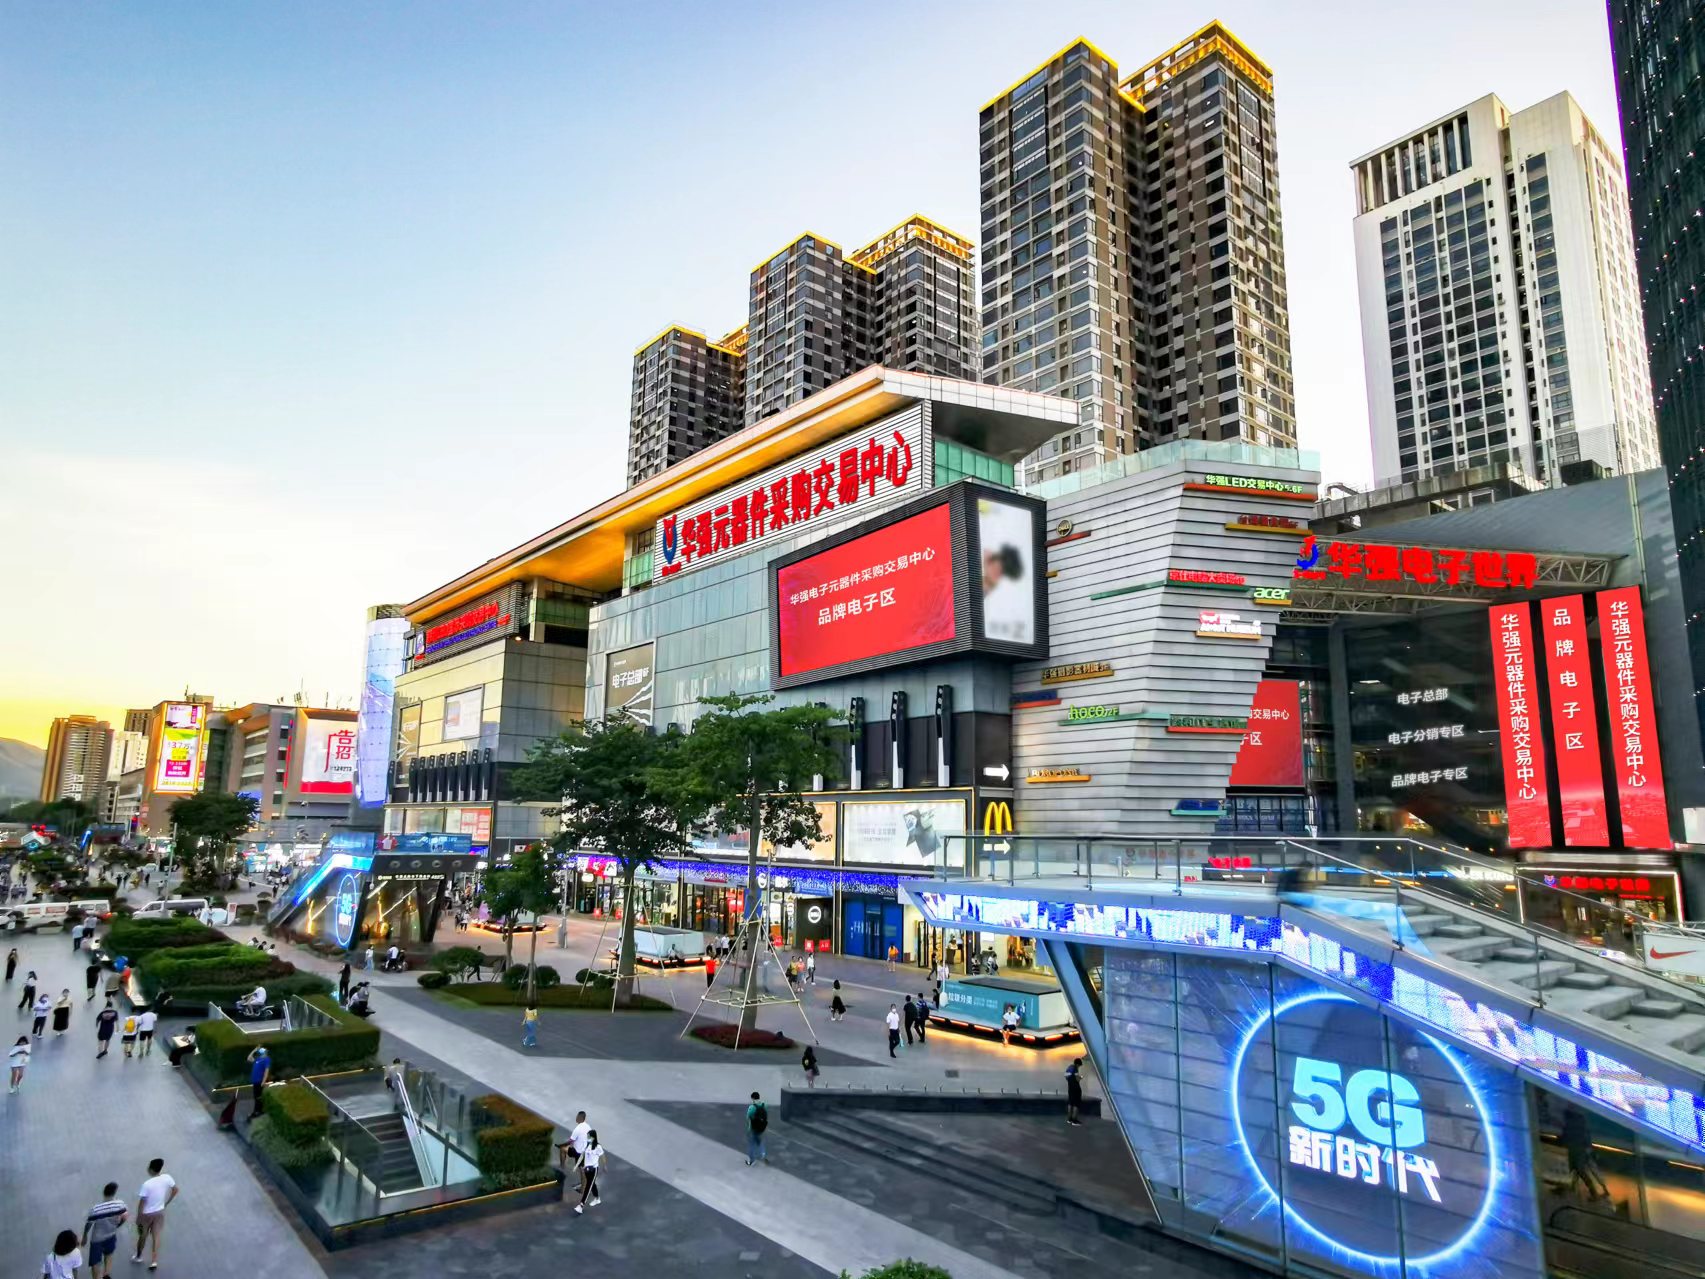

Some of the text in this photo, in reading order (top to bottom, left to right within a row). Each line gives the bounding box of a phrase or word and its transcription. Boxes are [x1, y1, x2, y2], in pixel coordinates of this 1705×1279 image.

[680, 430, 913, 563] 华强元器件采购交易中心
[790, 547, 936, 606] 华强电子元器件采购交易中心
[1254, 588, 1290, 600] acer
[1327, 541, 1538, 589] 华强电子世界
[818, 587, 896, 625] 品牌电子区
[1397, 688, 1448, 705] 电子总部
[1500, 613, 1537, 800] 华强元器件采购交易中心
[1553, 608, 1584, 750] 品牌电子区
[1610, 601, 1647, 788] 华强元器件采购交易中心
[1388, 725, 1464, 745] 电子分销专区
[1391, 767, 1468, 788] 品牌电子专区
[1290, 1057, 1426, 1147] 5G
[1289, 1126, 1442, 1202] 新时代
